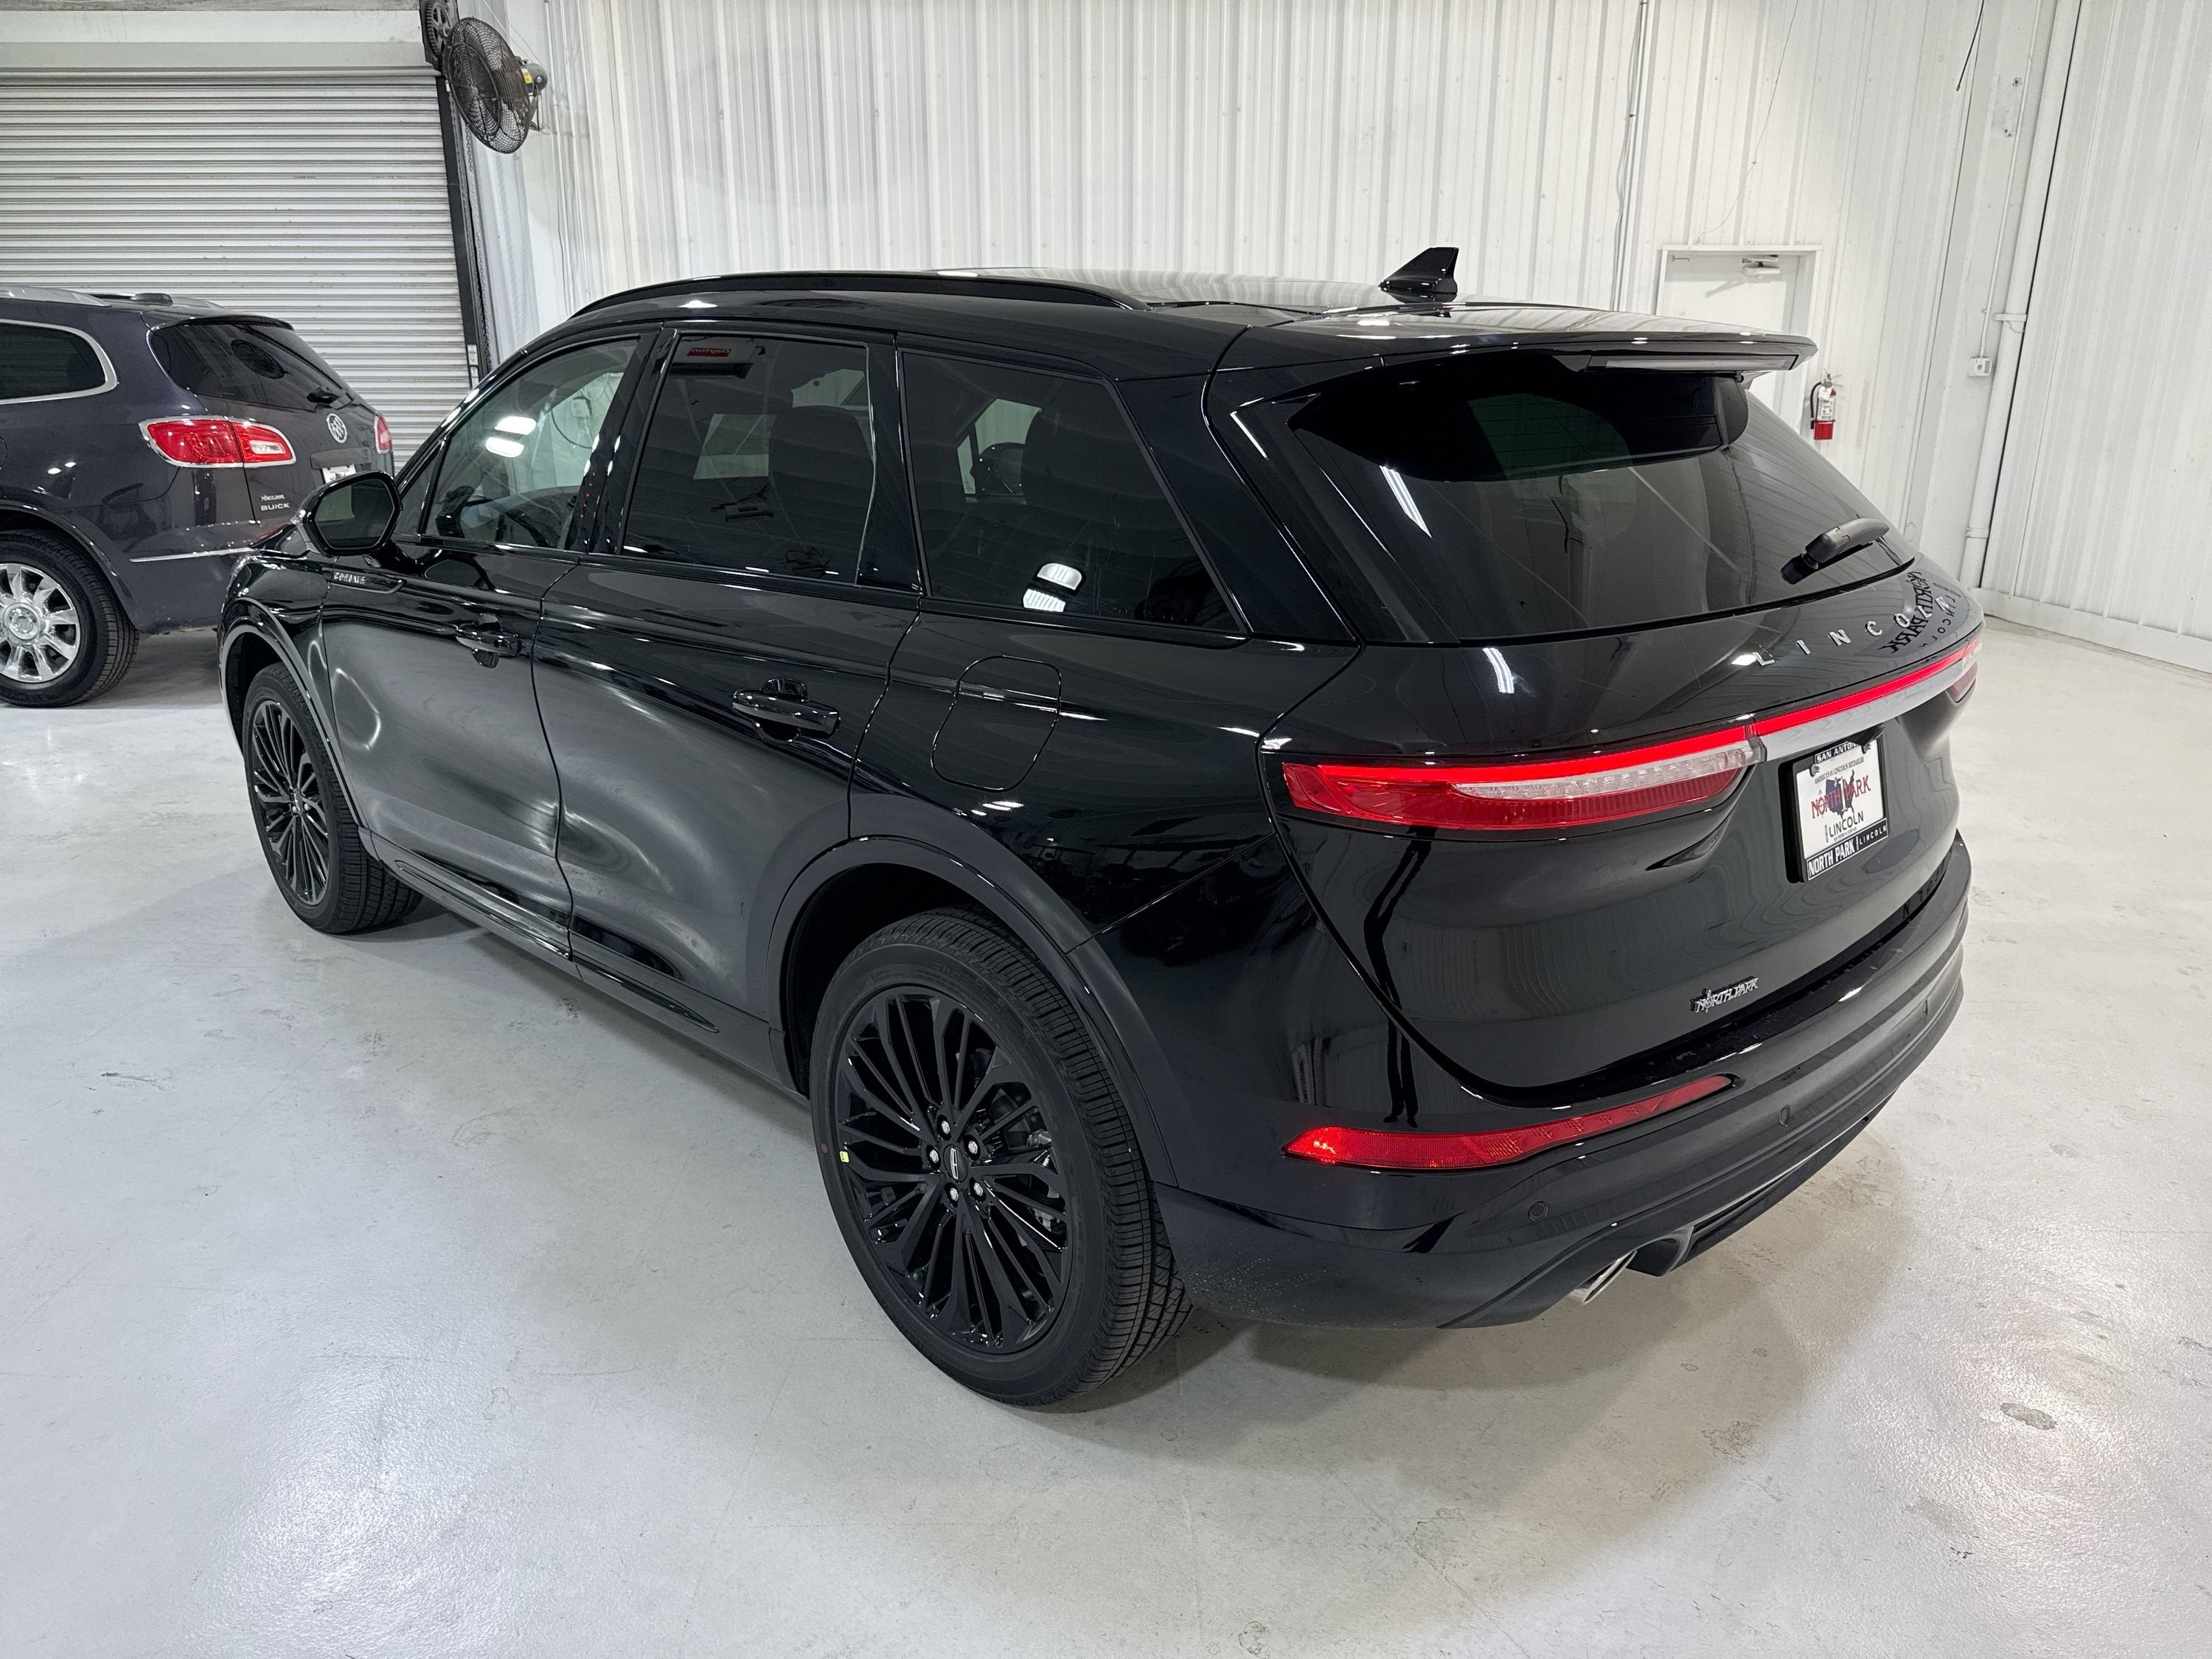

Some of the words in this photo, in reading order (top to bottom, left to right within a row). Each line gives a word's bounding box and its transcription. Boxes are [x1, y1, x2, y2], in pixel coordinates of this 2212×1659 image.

[260, 502, 290, 511] BUICK
[1752, 595, 1950, 667] LINCOLN
[1817, 750, 1832, 762] SAN
[1811, 787, 1842, 819] NORTH
[1844, 775, 1871, 801] PARK
[1829, 810, 1864, 838] LINCOLN
[1808, 849, 1834, 877] NORTH
[1835, 838, 1855, 863] PARK
[1860, 824, 1887, 845] LINCOLN
[1694, 990, 1734, 1013] NORTH
[1733, 977, 1759, 998] PARK
